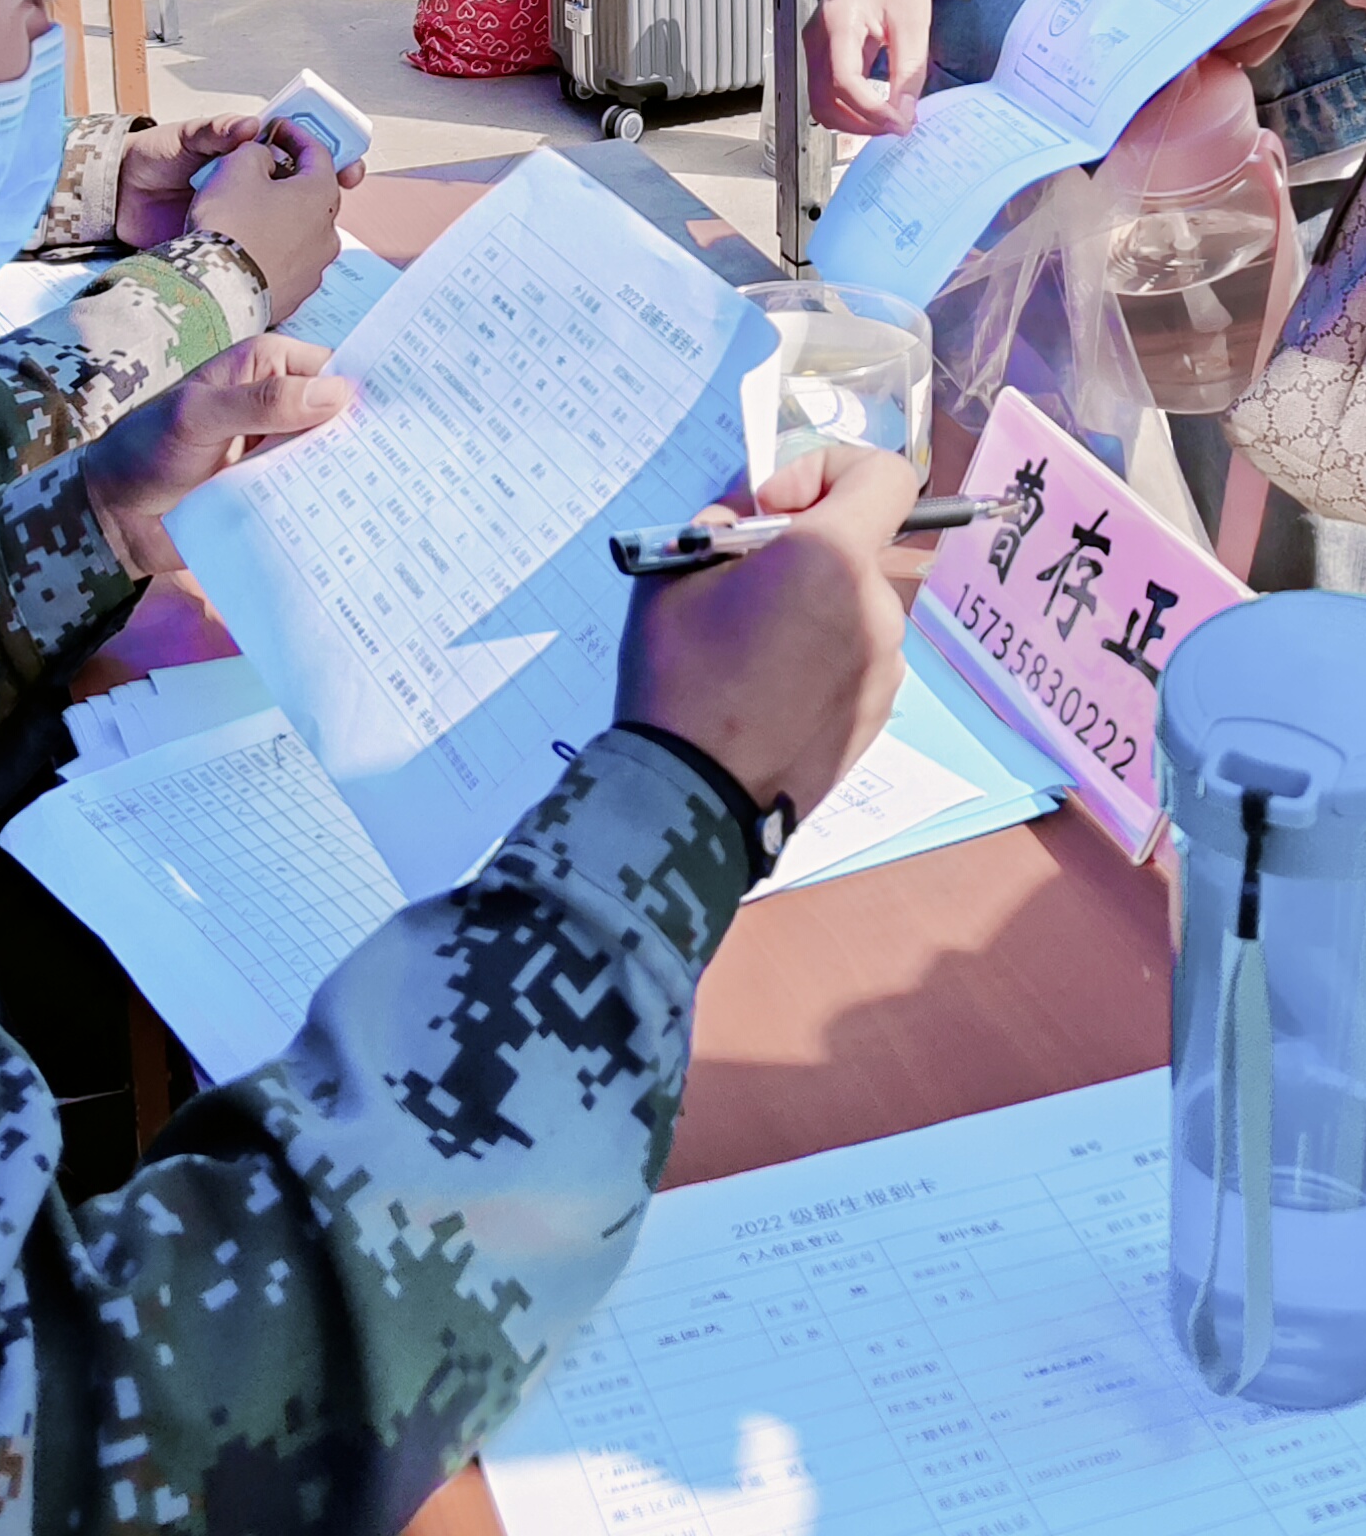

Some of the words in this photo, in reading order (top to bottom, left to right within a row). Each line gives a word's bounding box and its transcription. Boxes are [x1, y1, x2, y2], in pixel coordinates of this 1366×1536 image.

[615, 281, 646, 311] 2022
[637, 297, 707, 364] 级新生报到卡
[952, 583, 1139, 781] 15735830222
[730, 1212, 785, 1241] 2022
[788, 1173, 939, 1228] 级新生报到卡
